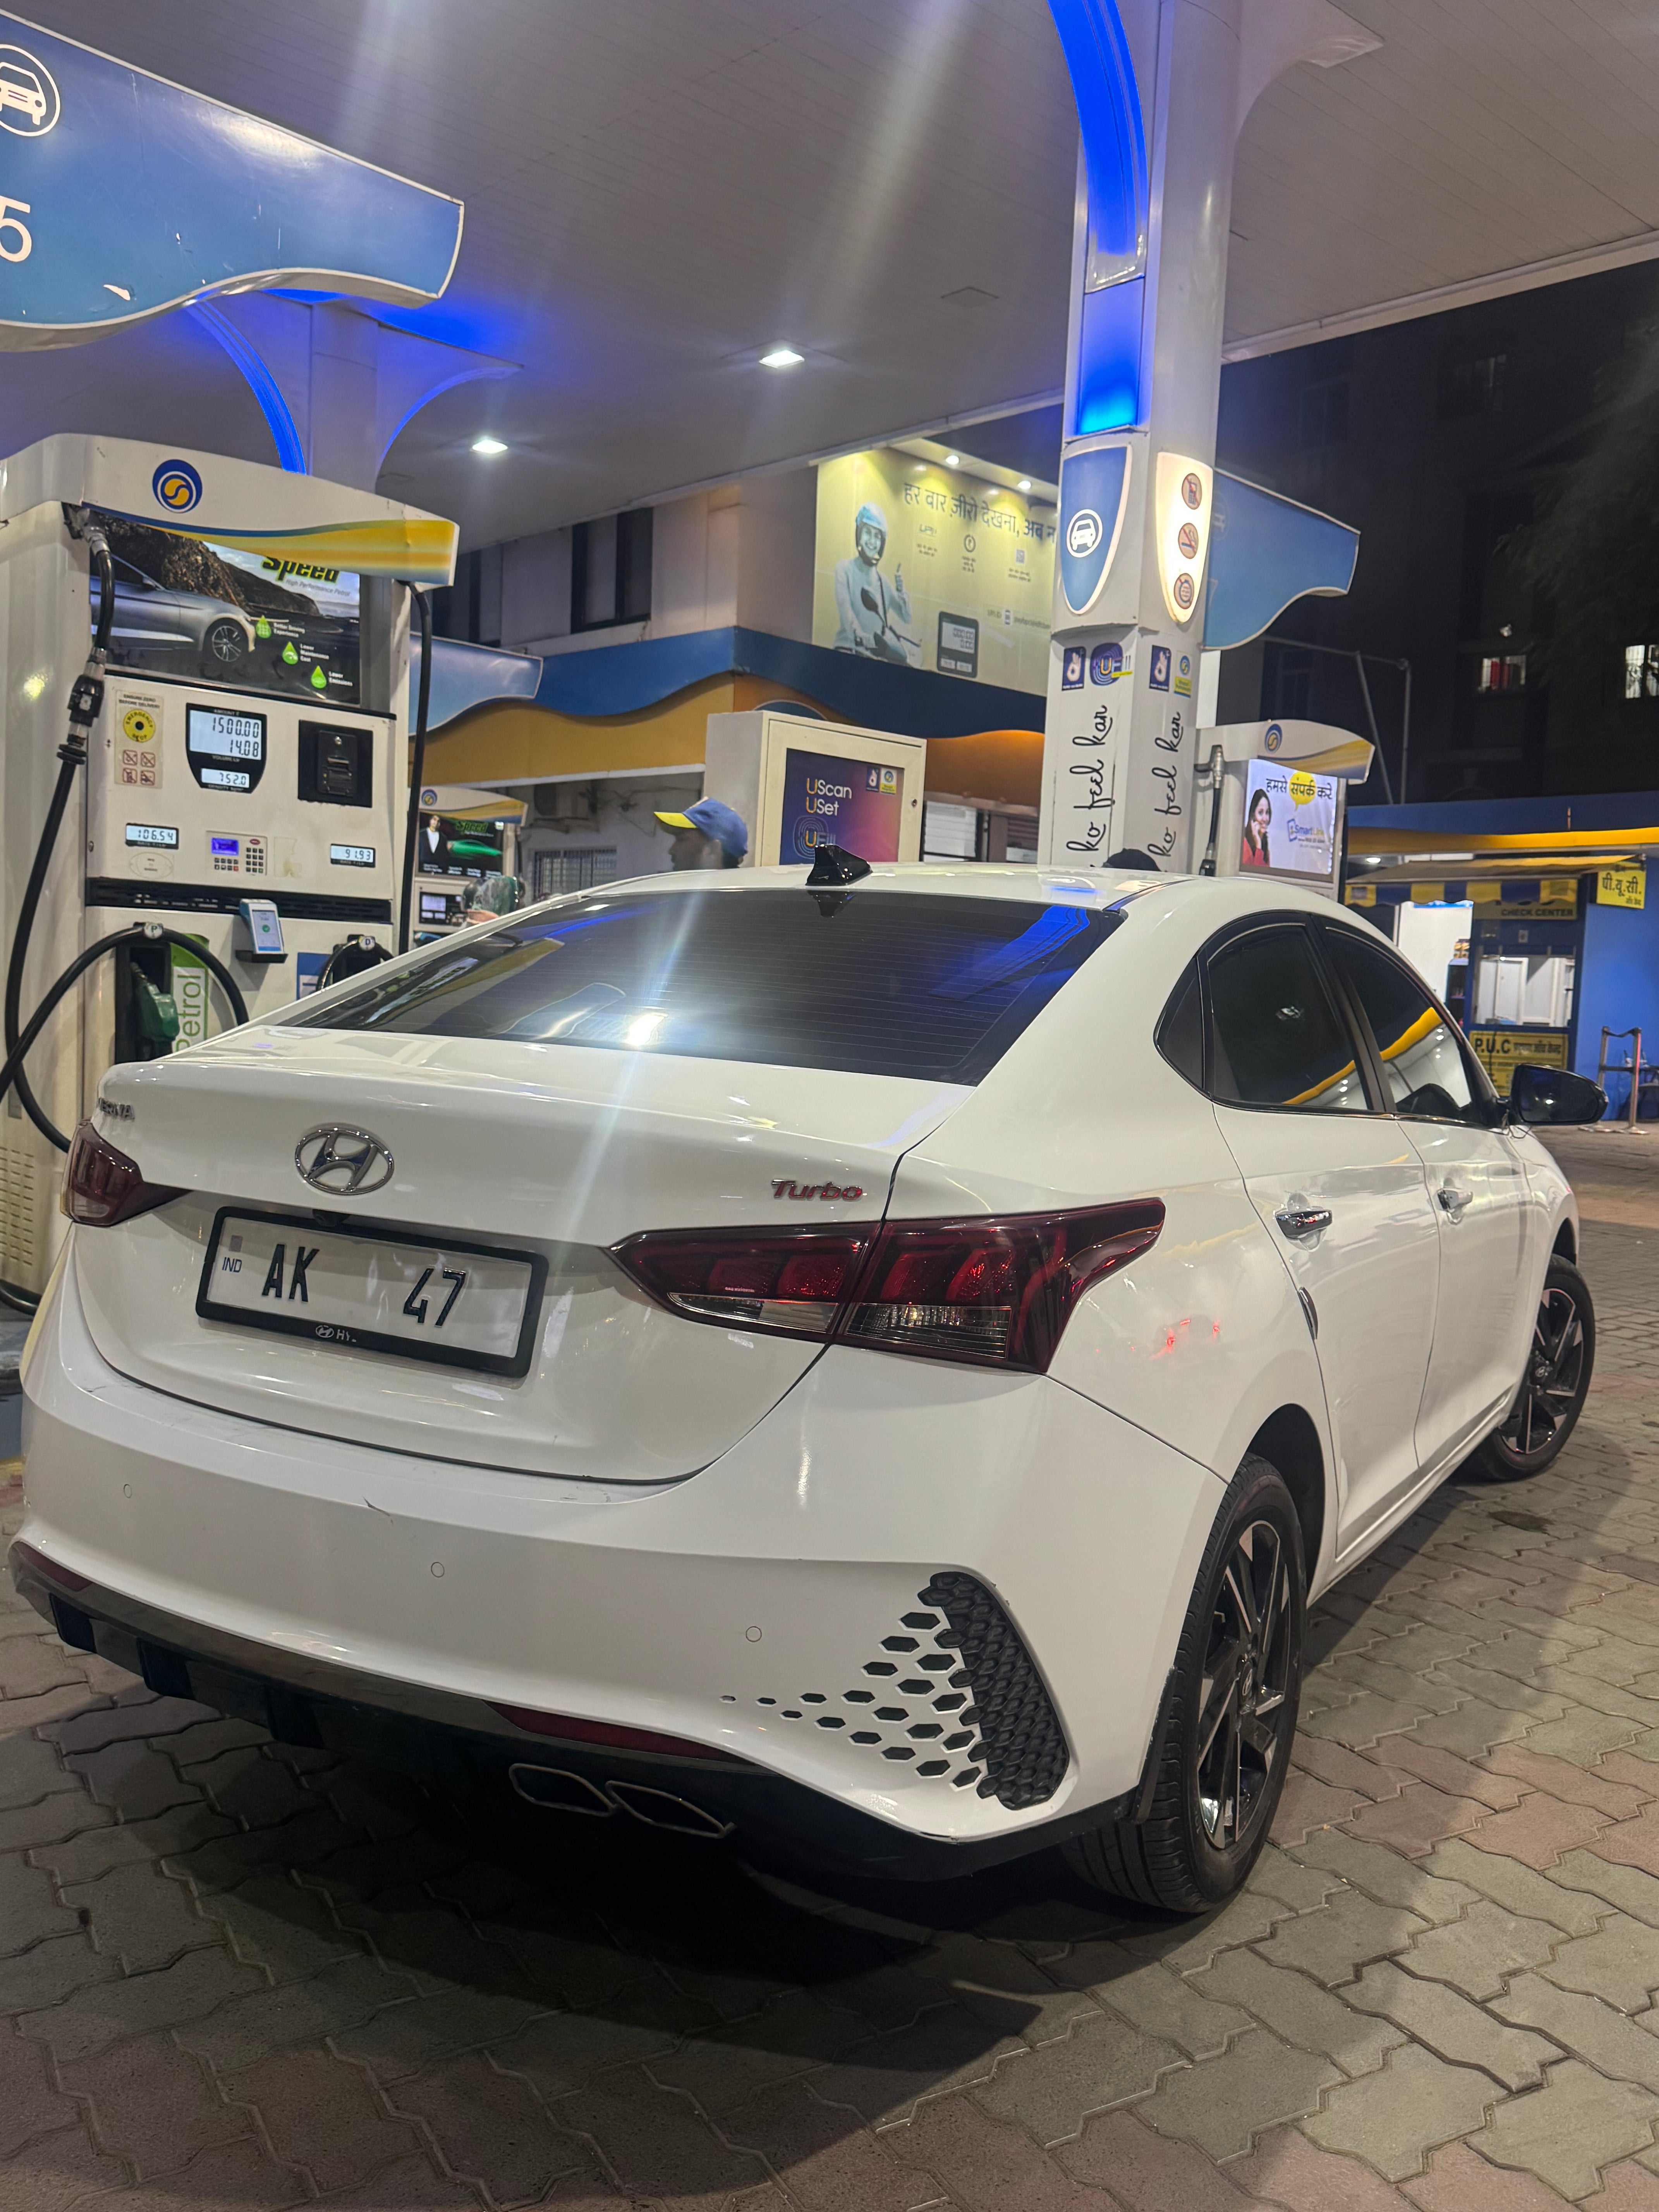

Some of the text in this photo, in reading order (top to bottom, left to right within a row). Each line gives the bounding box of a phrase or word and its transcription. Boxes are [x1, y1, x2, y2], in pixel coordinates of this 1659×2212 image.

[0, 197, 32, 262] 5
[905, 483, 920, 504] हर
[263, 557, 339, 583] Speed
[213, 717, 259, 738] 1500.00
[230, 739, 259, 757] 14.08
[219, 772, 247, 786] 752.0
[806, 778, 852, 799] UScan
[1070, 759, 1115, 809] feel
[1266, 775, 1288, 793] हमसे
[1152, 765, 1182, 816] feel
[805, 796, 839, 816] USet
[138, 829, 173, 841] 106.54
[345, 848, 371, 860] 91.93
[1535, 908, 1573, 917] CENTER
[1475, 1038, 1510, 1054] P.U.C
[772, 1179, 863, 1200] Turbo
[222, 1257, 242, 1273] IND
[261, 1244, 467, 1327] AK 47
